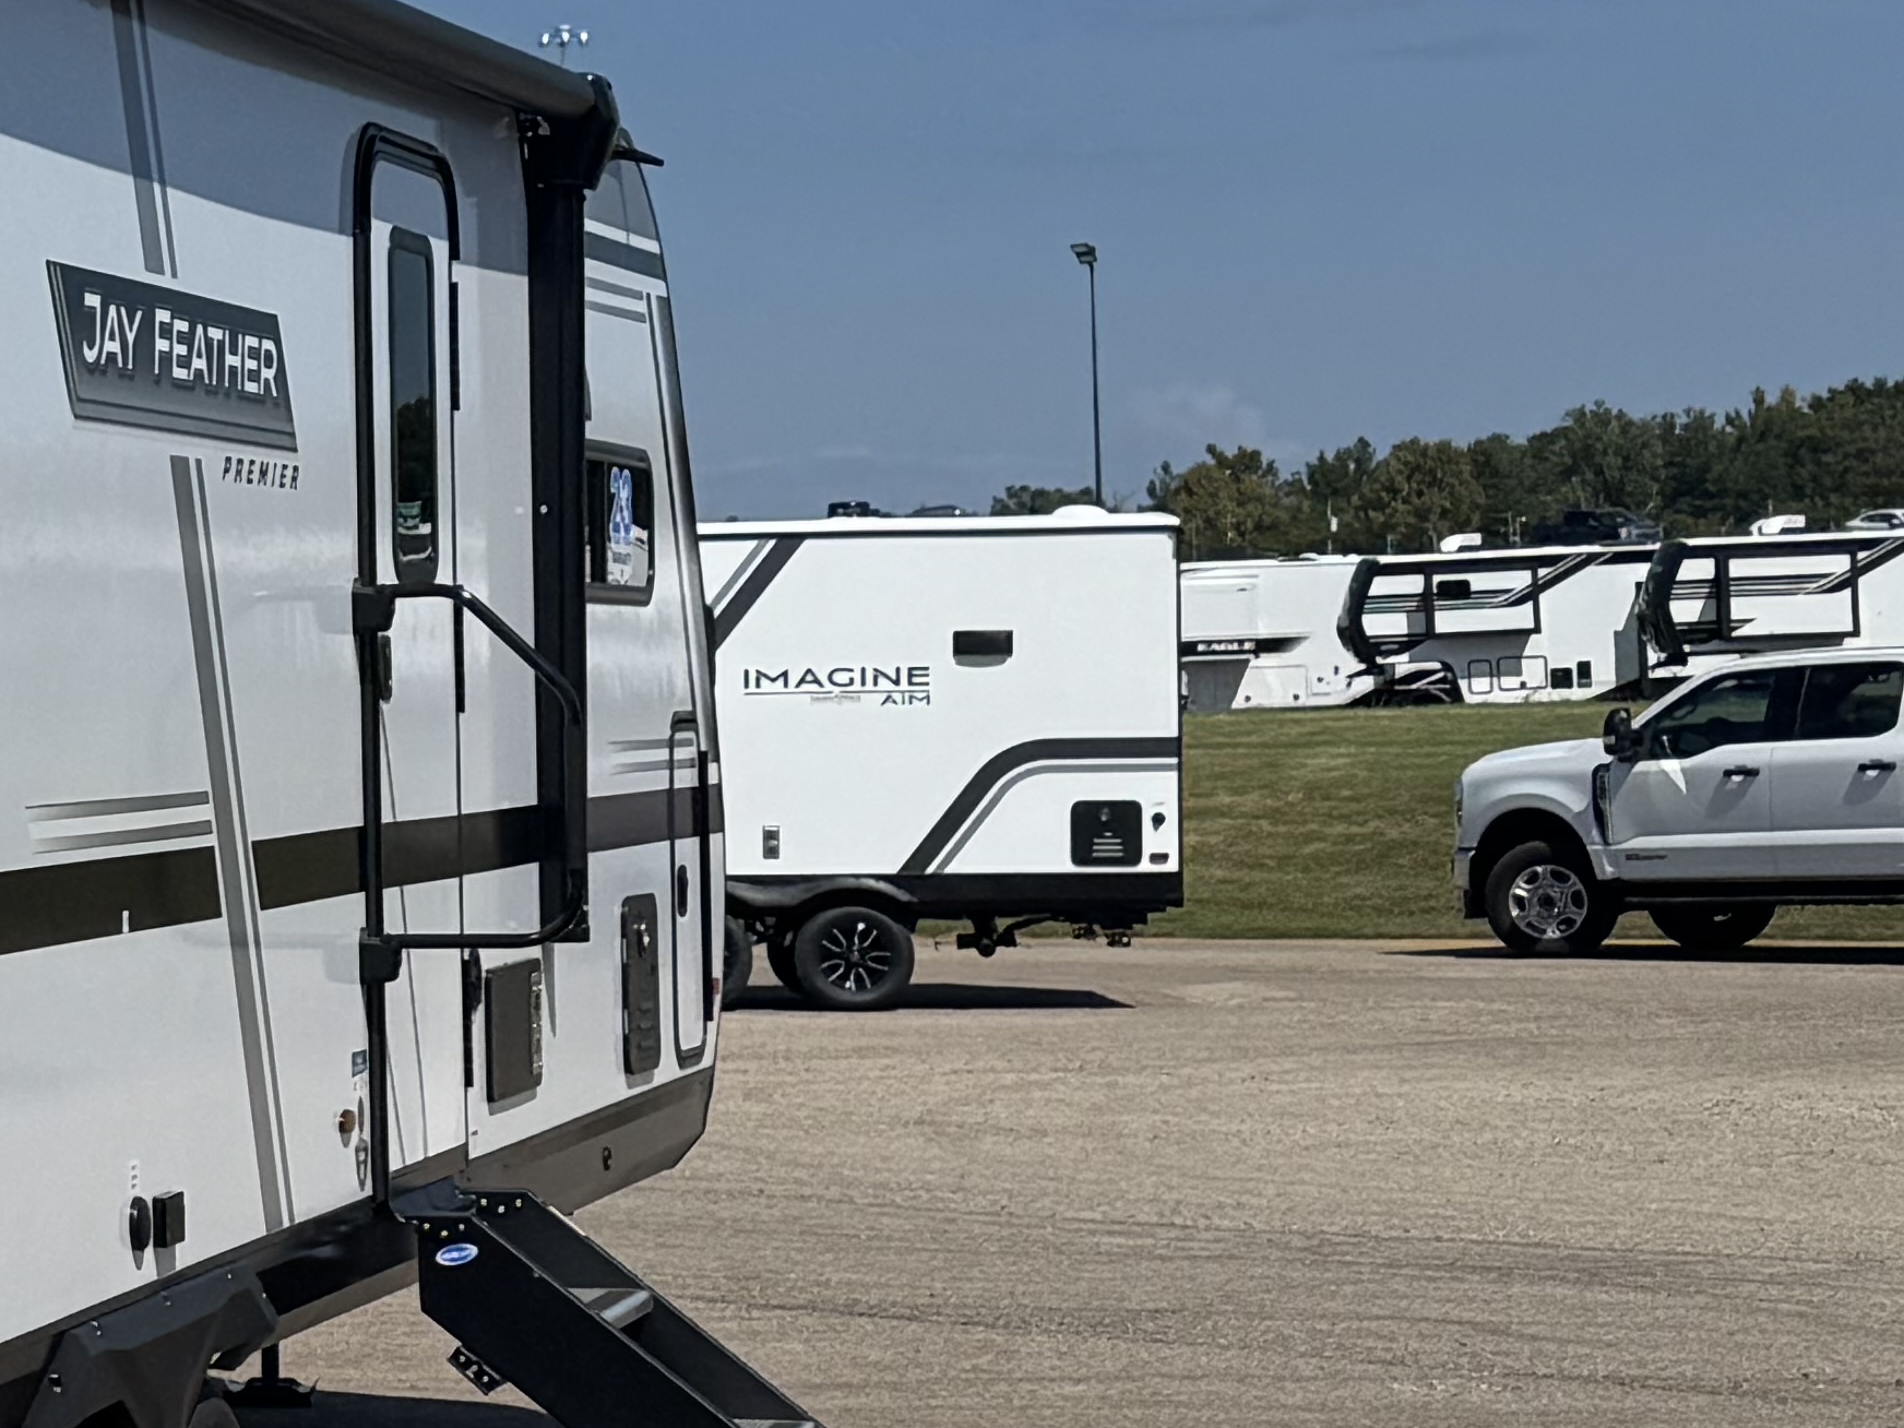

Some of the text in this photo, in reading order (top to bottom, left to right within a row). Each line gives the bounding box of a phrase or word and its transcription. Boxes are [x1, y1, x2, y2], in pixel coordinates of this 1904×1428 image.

[82, 291, 278, 398] JAY FEATHER
[221, 455, 300, 491] PREMIER
[743, 666, 931, 690] IMAGINE
